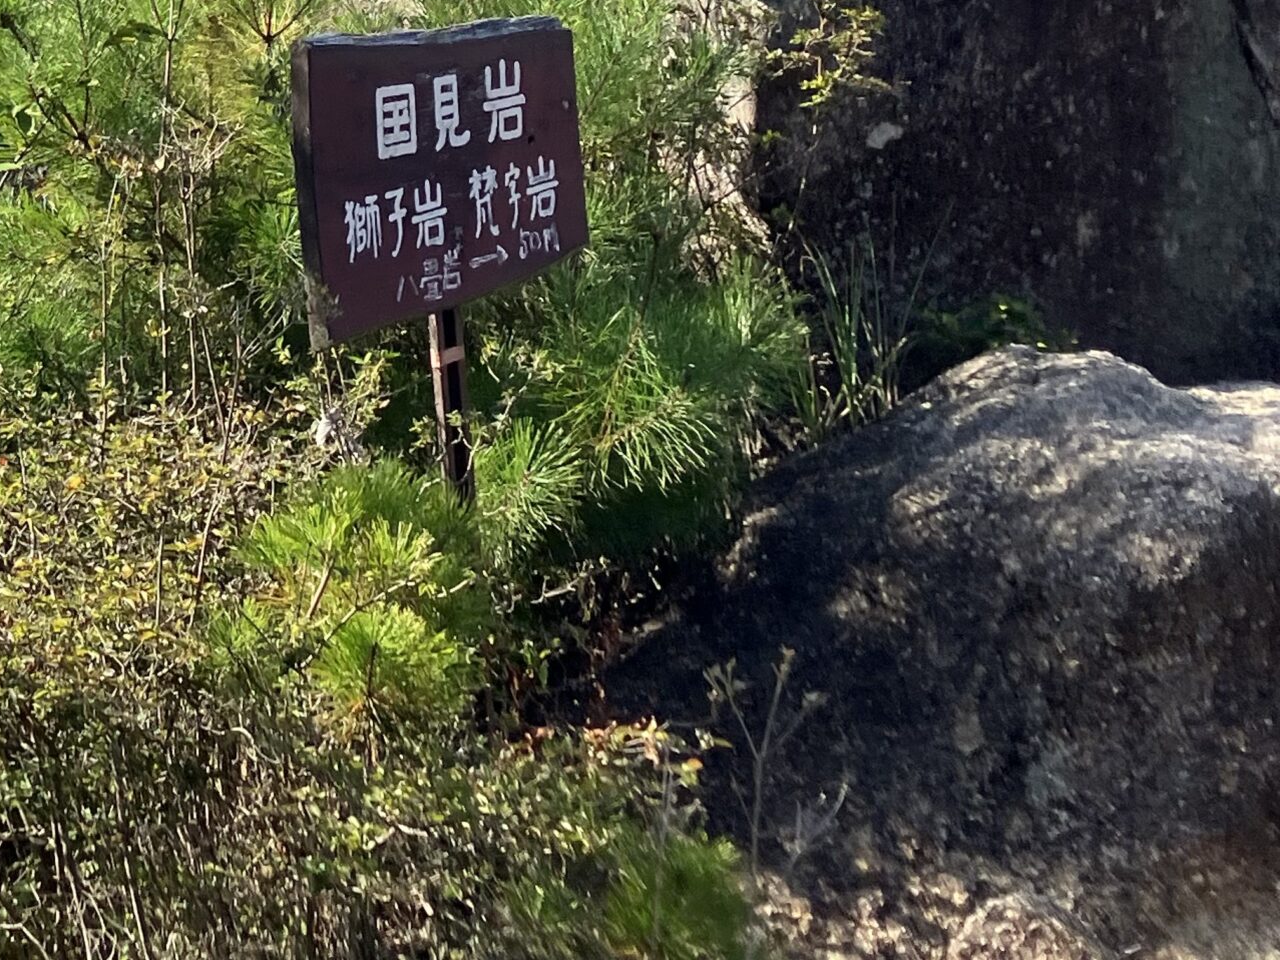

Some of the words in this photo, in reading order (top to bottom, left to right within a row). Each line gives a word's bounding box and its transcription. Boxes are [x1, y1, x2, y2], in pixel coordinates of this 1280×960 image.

[375, 58, 526, 160] 国見岩
[469, 155, 559, 239] 梵字岩
